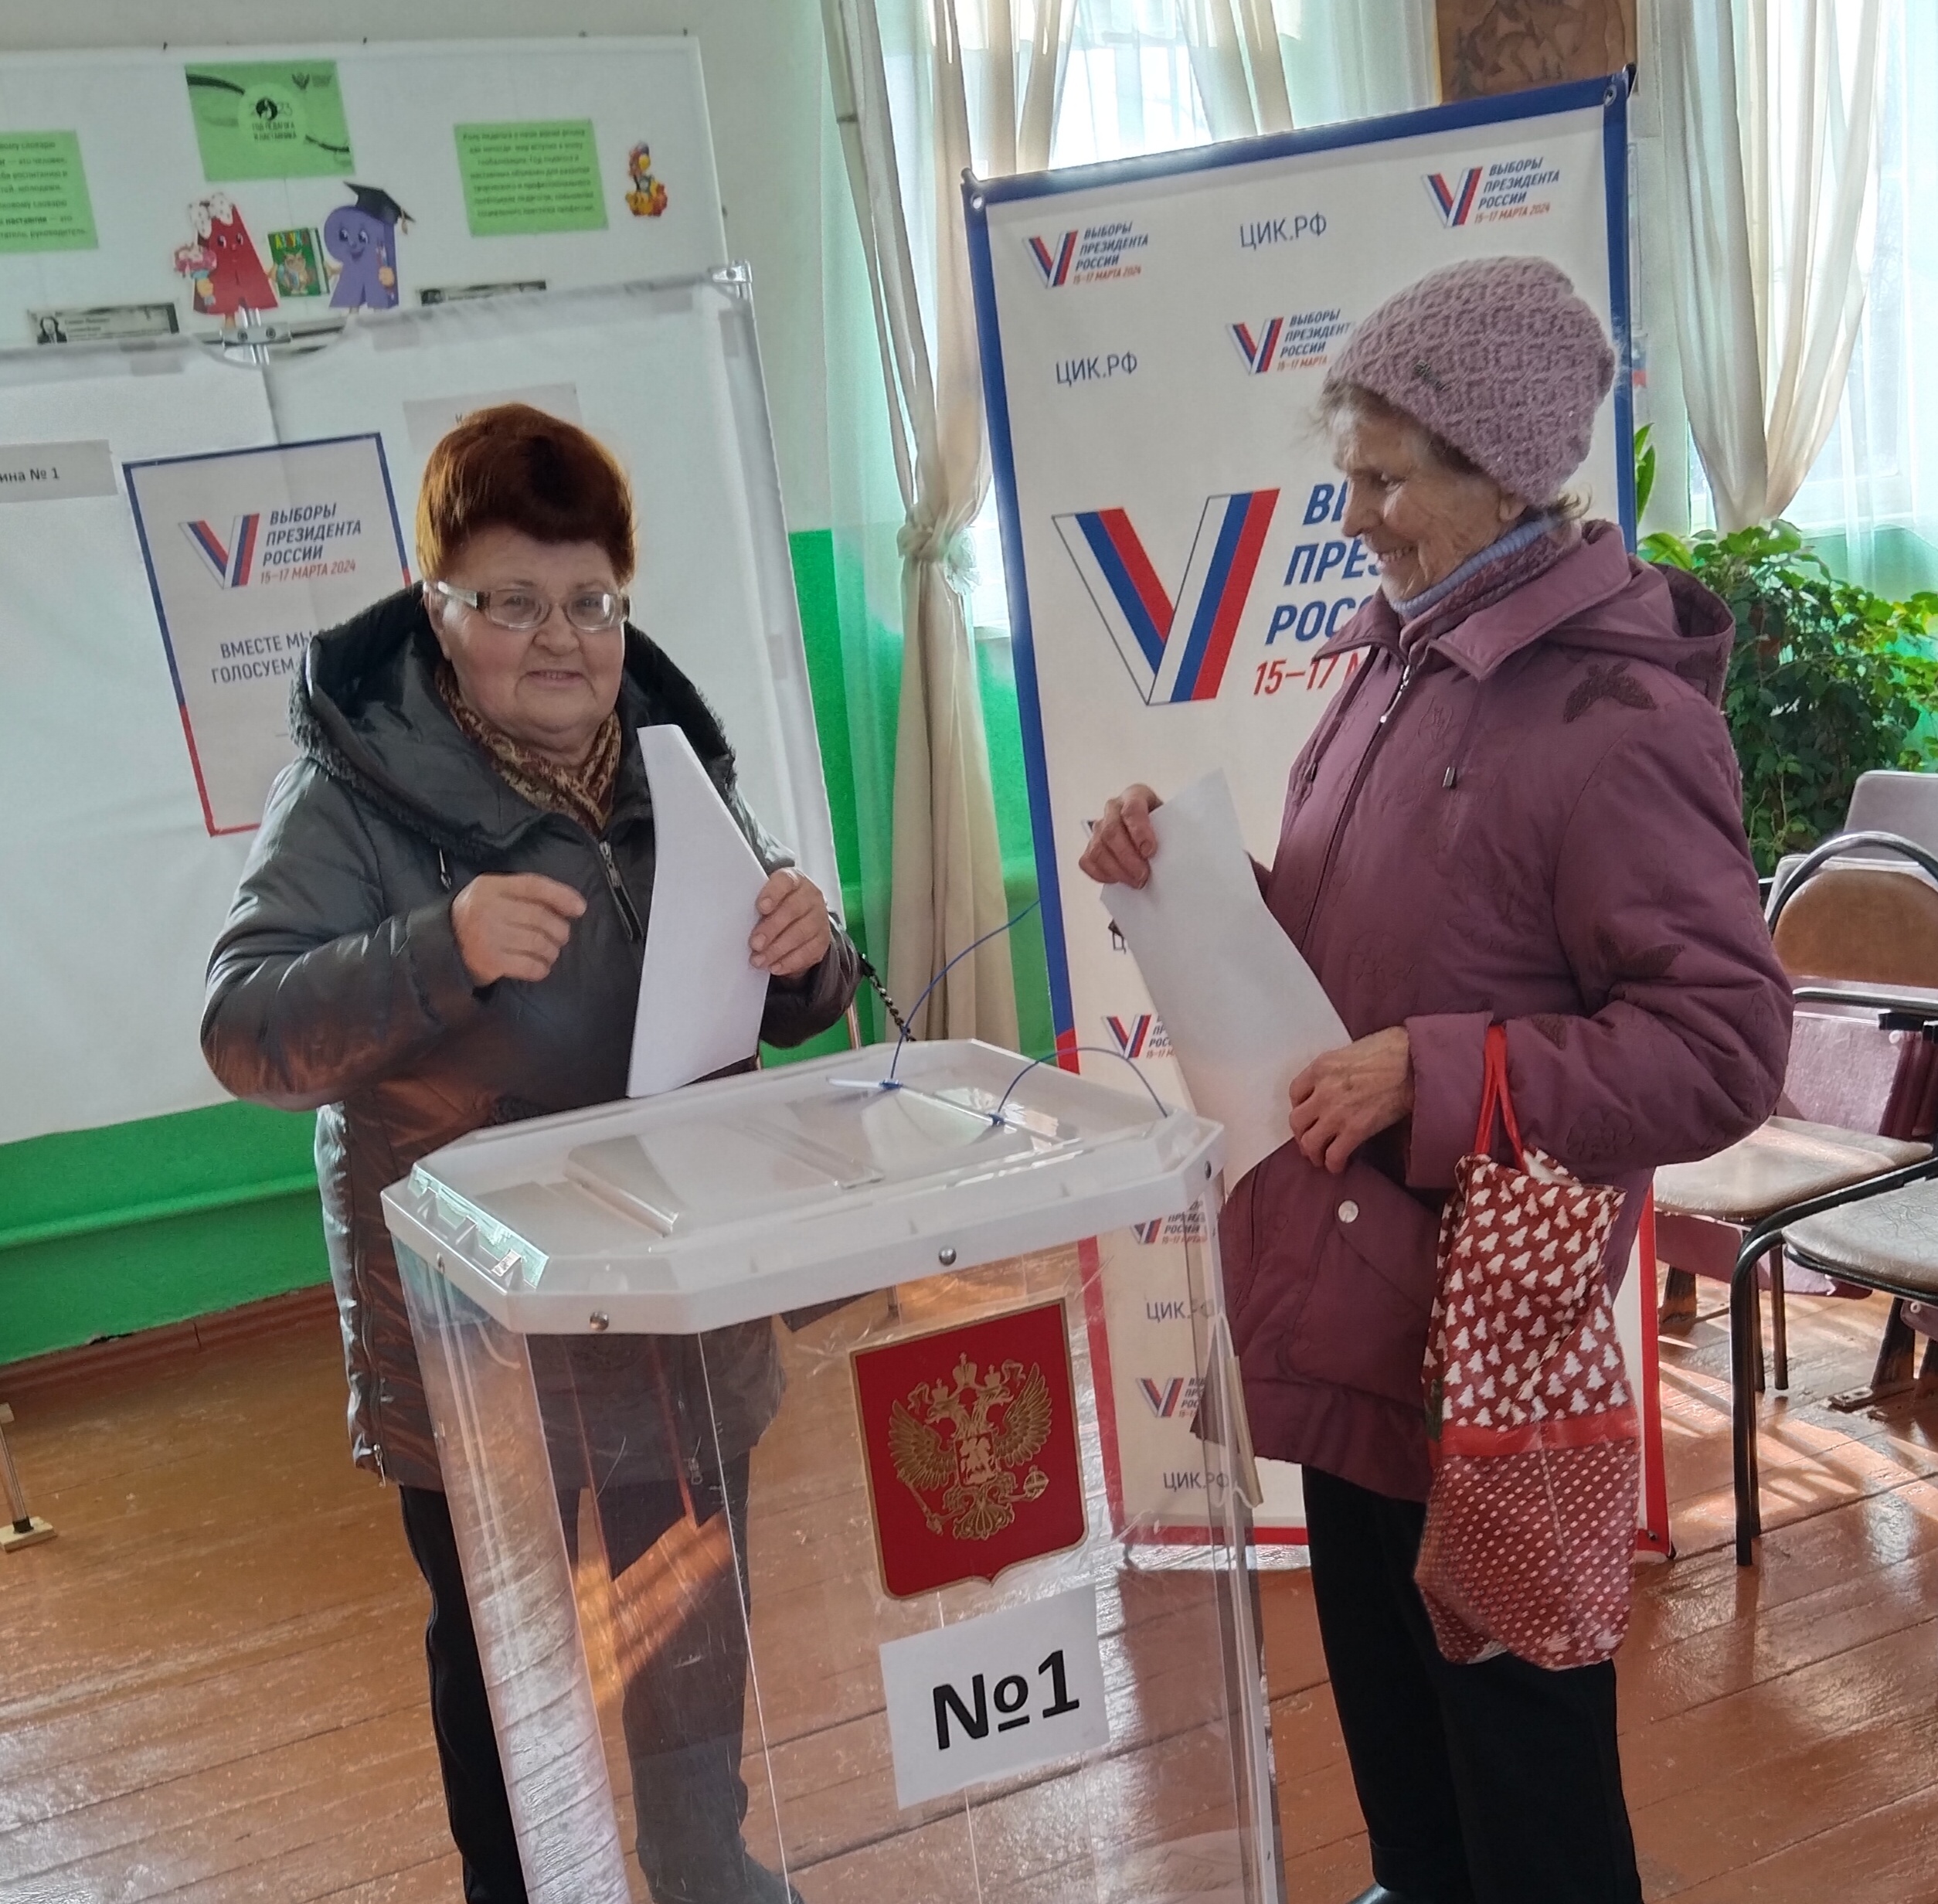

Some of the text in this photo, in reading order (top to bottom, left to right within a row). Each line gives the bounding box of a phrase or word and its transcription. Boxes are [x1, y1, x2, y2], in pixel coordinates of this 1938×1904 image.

[1489, 157, 1543, 177] ВЫБОРЫ
[1483, 170, 1560, 193] ПРЕЗИДЕНТА
[1477, 192, 1527, 210] РОССИИ
[1498, 206, 1528, 220] МАРТА
[1530, 202, 1551, 216] 2024
[1083, 219, 1133, 240] ВЫБОРЫ
[1240, 211, 1327, 251] ЦИК.РФ
[1079, 233, 1149, 257] ПРЕЗИДЕНТА
[1075, 254, 1120, 272] РОССИИ
[1094, 269, 1120, 282] МАРТА
[1289, 308, 1341, 328] ВЫБОРЫ
[1284, 321, 1354, 342] ПРЕЗИДЕНТ
[1280, 341, 1326, 359] РОССИИ
[1056, 350, 1137, 388] ЦИК.РФ
[1299, 355, 1328, 369] МАРТА
[29, 468, 47, 481] №
[51, 467, 60, 480] 1
[270, 502, 337, 525] ВЫБОРЫ
[266, 519, 362, 546] ПРЕЗИДЕНТА
[263, 544, 324, 566] РОССИИ
[291, 563, 329, 581] МАРТА
[330, 559, 357, 576] 2024
[220, 634, 283, 659] ВМЕСТЕ
[211, 656, 295, 685] ГОЛОСУЕМ
[931, 1648, 1080, 1750] №1
